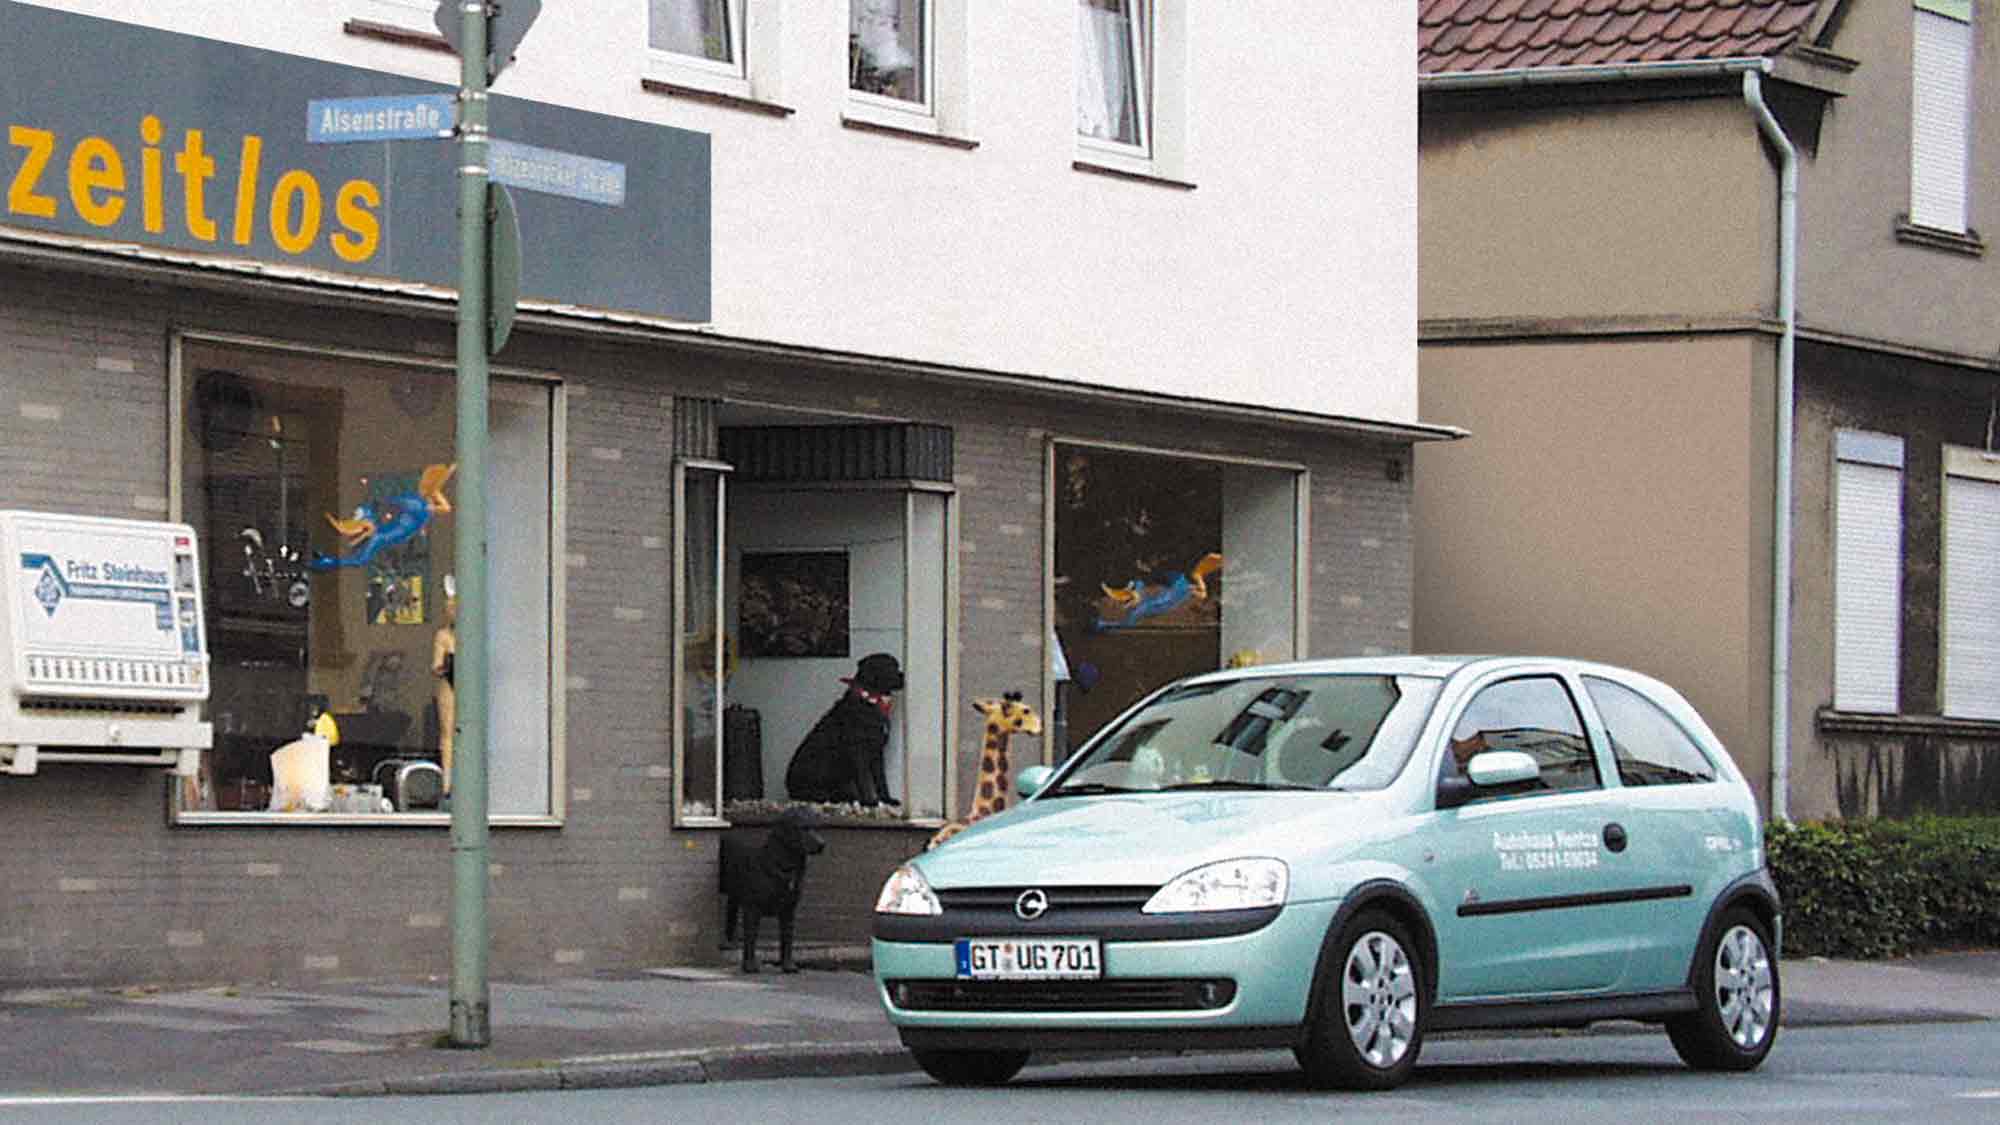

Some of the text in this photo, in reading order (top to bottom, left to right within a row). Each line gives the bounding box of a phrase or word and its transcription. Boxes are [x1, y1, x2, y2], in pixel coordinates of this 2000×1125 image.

[320, 105, 440, 134] Alsenstraße
[9, 115, 382, 264] zeitlos
[66, 559, 97, 580] Fritz
[972, 944, 1097, 970] GT UG 701
